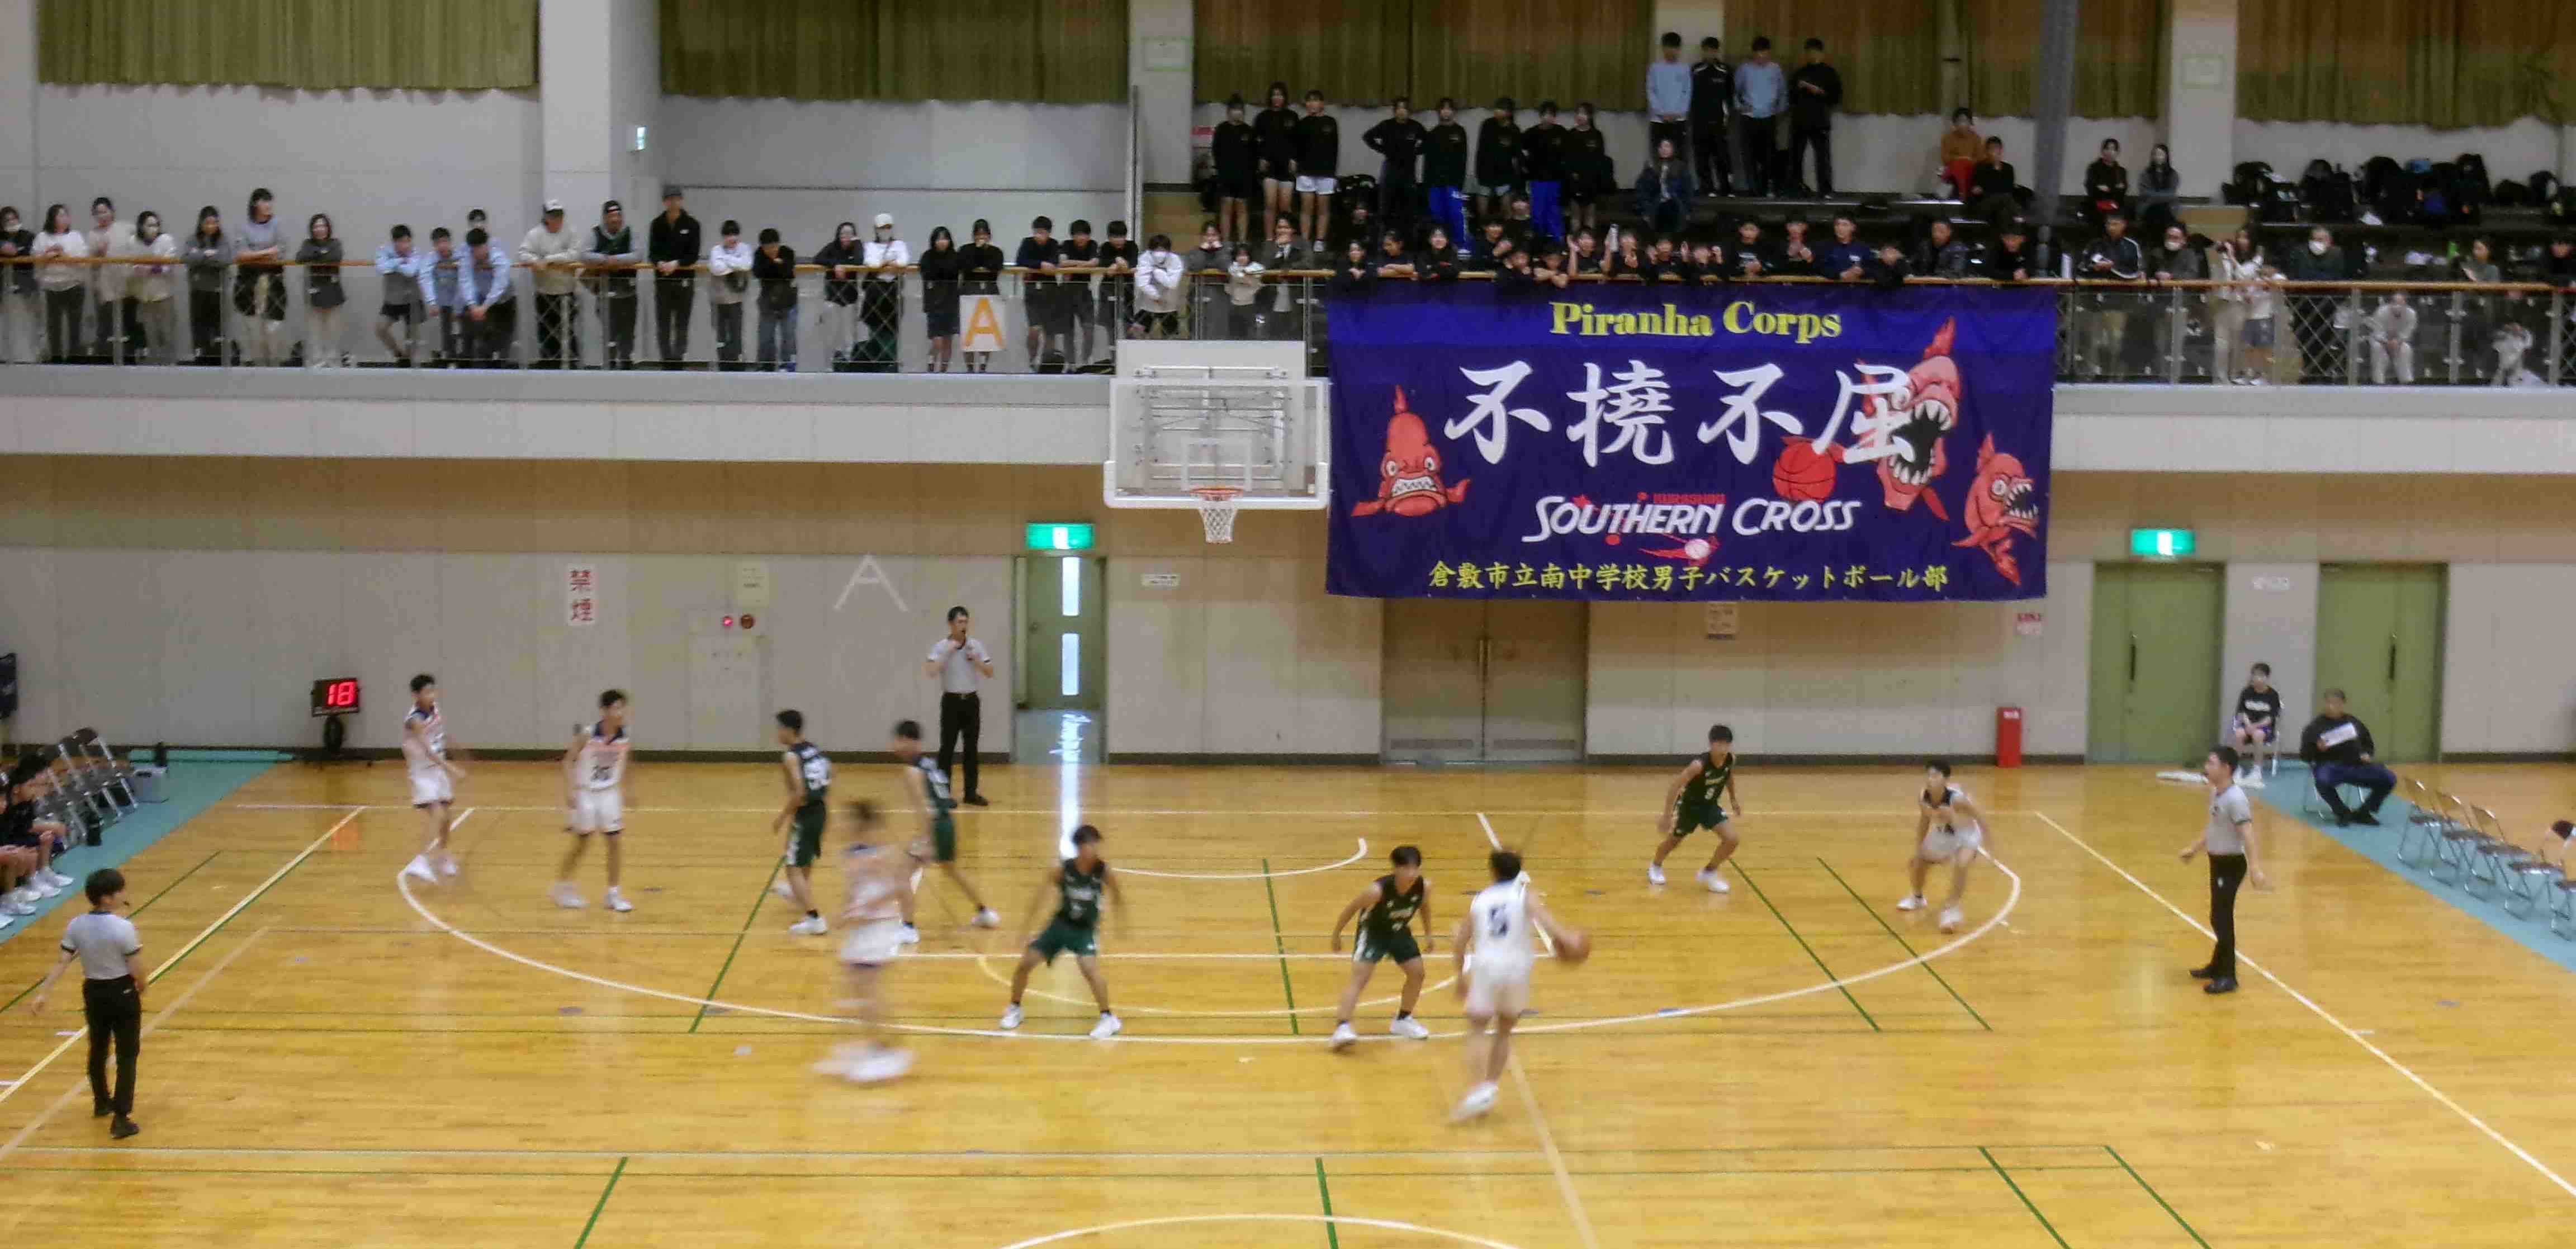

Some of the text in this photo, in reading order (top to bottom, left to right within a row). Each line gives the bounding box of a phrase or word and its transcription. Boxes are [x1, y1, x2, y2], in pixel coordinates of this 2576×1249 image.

[962, 297, 1006, 348] A
[1551, 301, 1841, 343] Piranha Corps
[1443, 359, 1917, 467] 不撓不屈
[1732, 497, 1863, 536] CROSS
[569, 569, 593, 622] 禁煙
[834, 553, 910, 612] A
[1429, 560, 1948, 592] 倉敷市立南中学校男子バスケットボール部
[328, 681, 355, 706] 18
